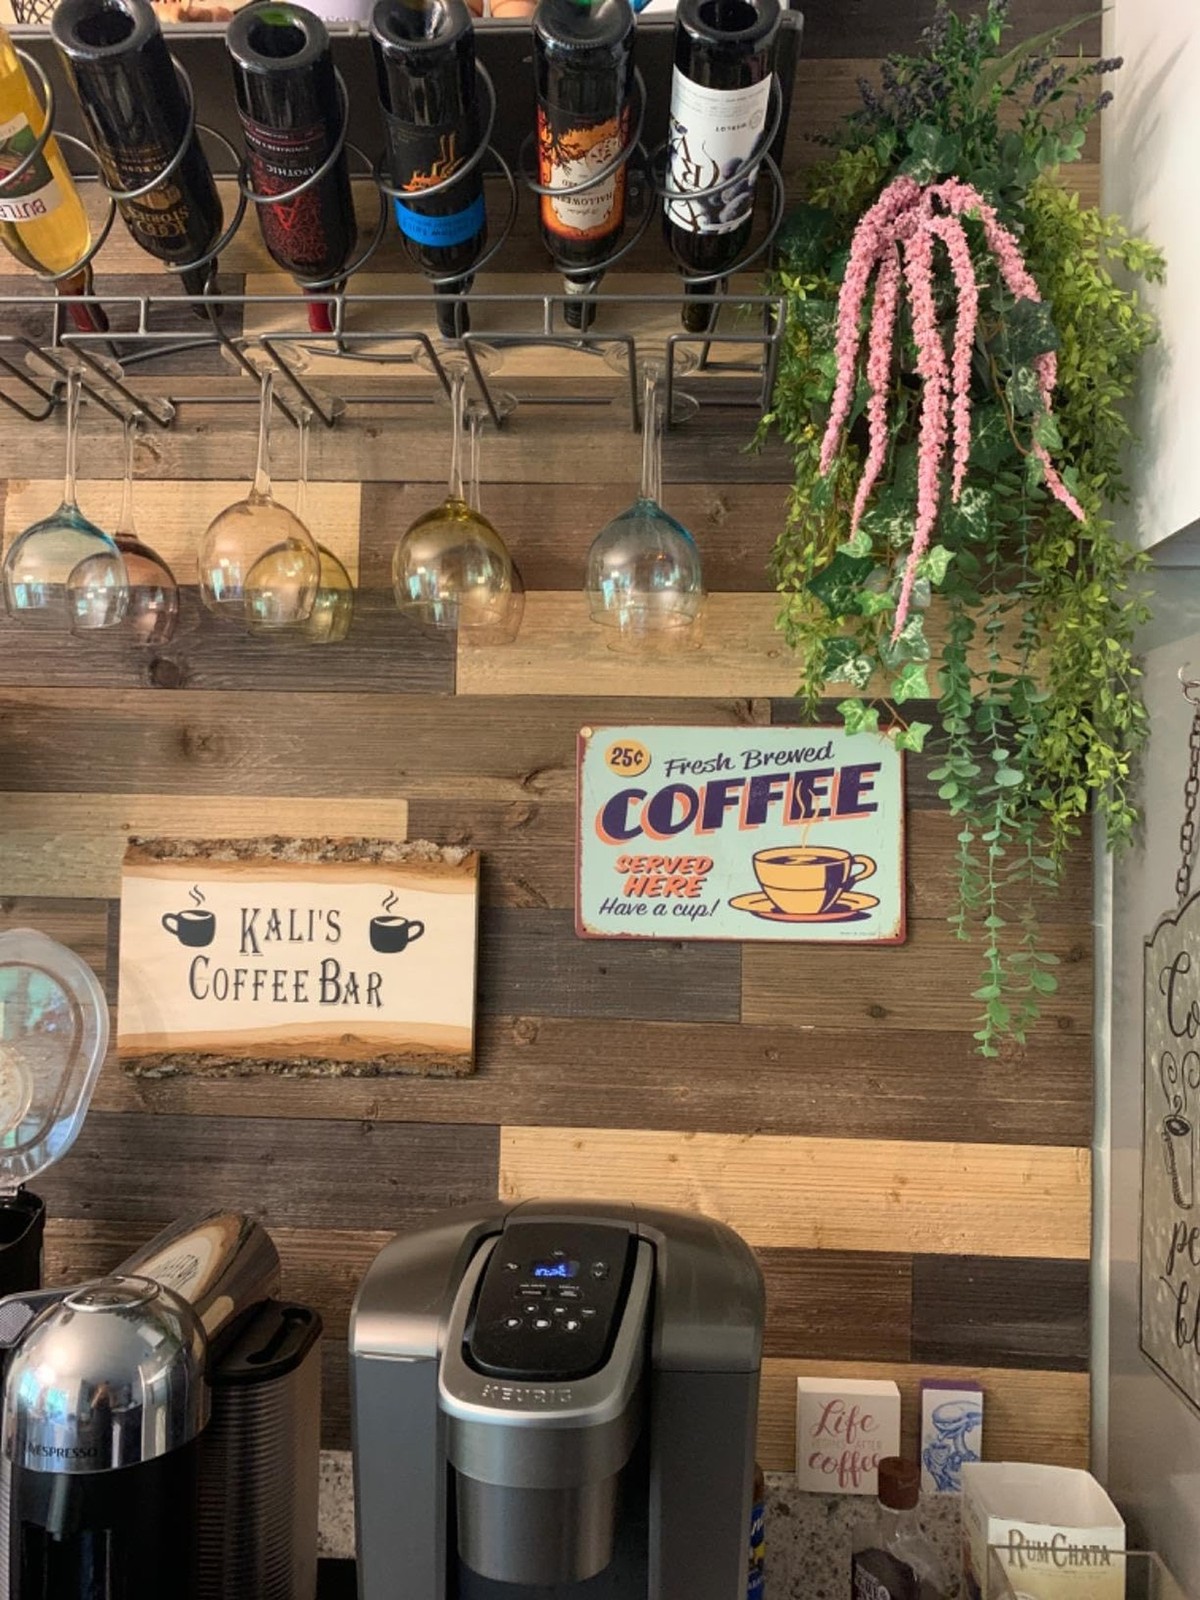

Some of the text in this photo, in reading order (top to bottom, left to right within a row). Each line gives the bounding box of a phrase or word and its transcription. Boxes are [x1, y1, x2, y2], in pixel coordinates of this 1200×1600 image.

[265, 164, 316, 177] APOTHIC
[664, 740, 834, 777] Fresh Brewed
[596, 762, 882, 845] COFFEE
[614, 854, 714, 876] SERVED
[623, 875, 707, 898] HERE
[598, 897, 721, 922] Have a cup!
[239, 907, 342, 955] KALI'S
[189, 954, 384, 1009] COFFEE BAR
[810, 1398, 880, 1444] Life
[27, 1443, 98, 1459] NESPRESSO
[808, 1450, 880, 1488] coffee
